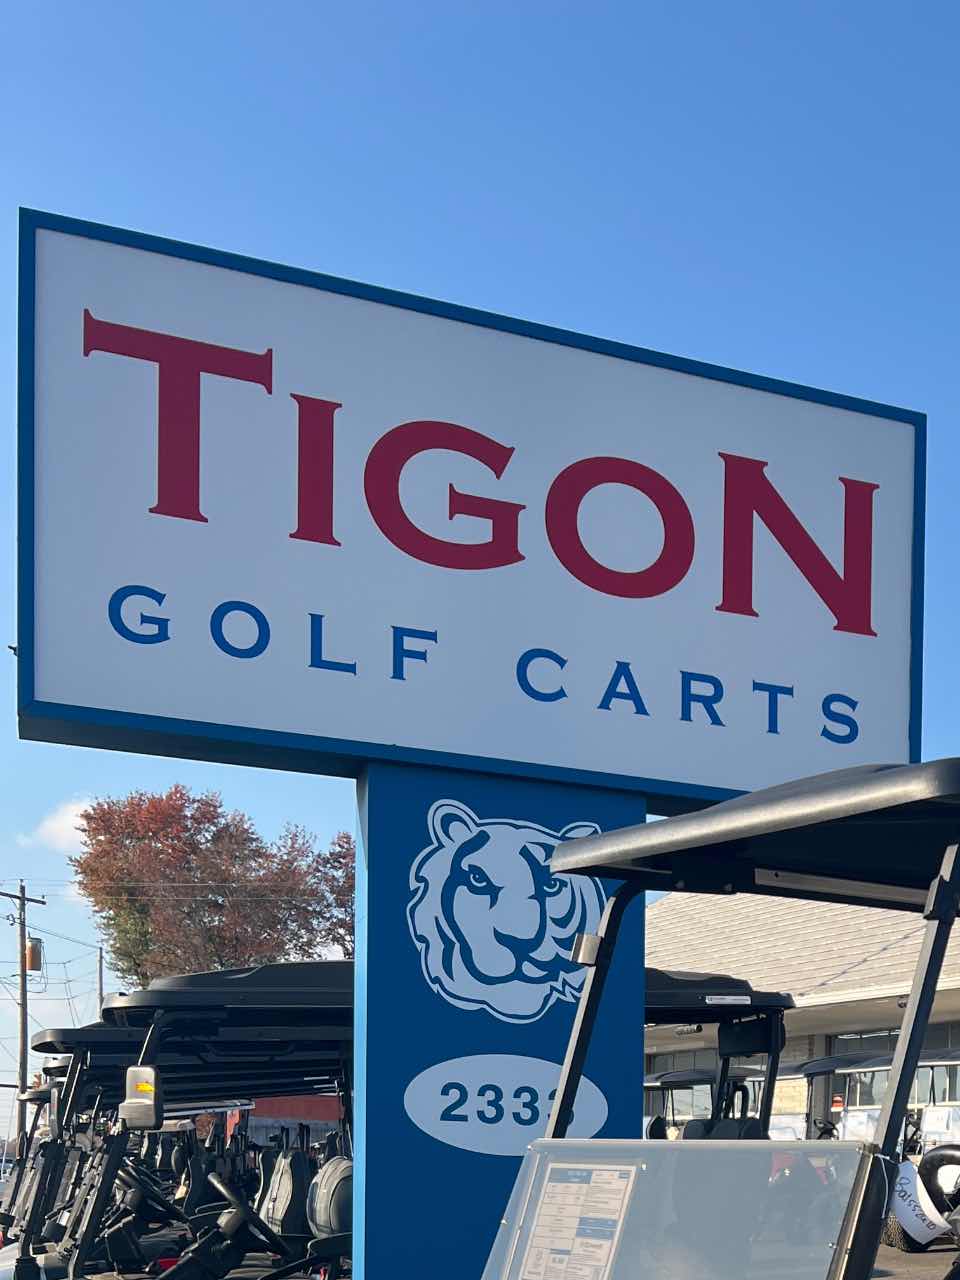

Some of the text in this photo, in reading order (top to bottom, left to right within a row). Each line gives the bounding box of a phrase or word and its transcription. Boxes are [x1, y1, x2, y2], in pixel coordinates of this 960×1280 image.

[83, 308, 879, 637] TIGON
[108, 583, 860, 745] GOLF CARTS
